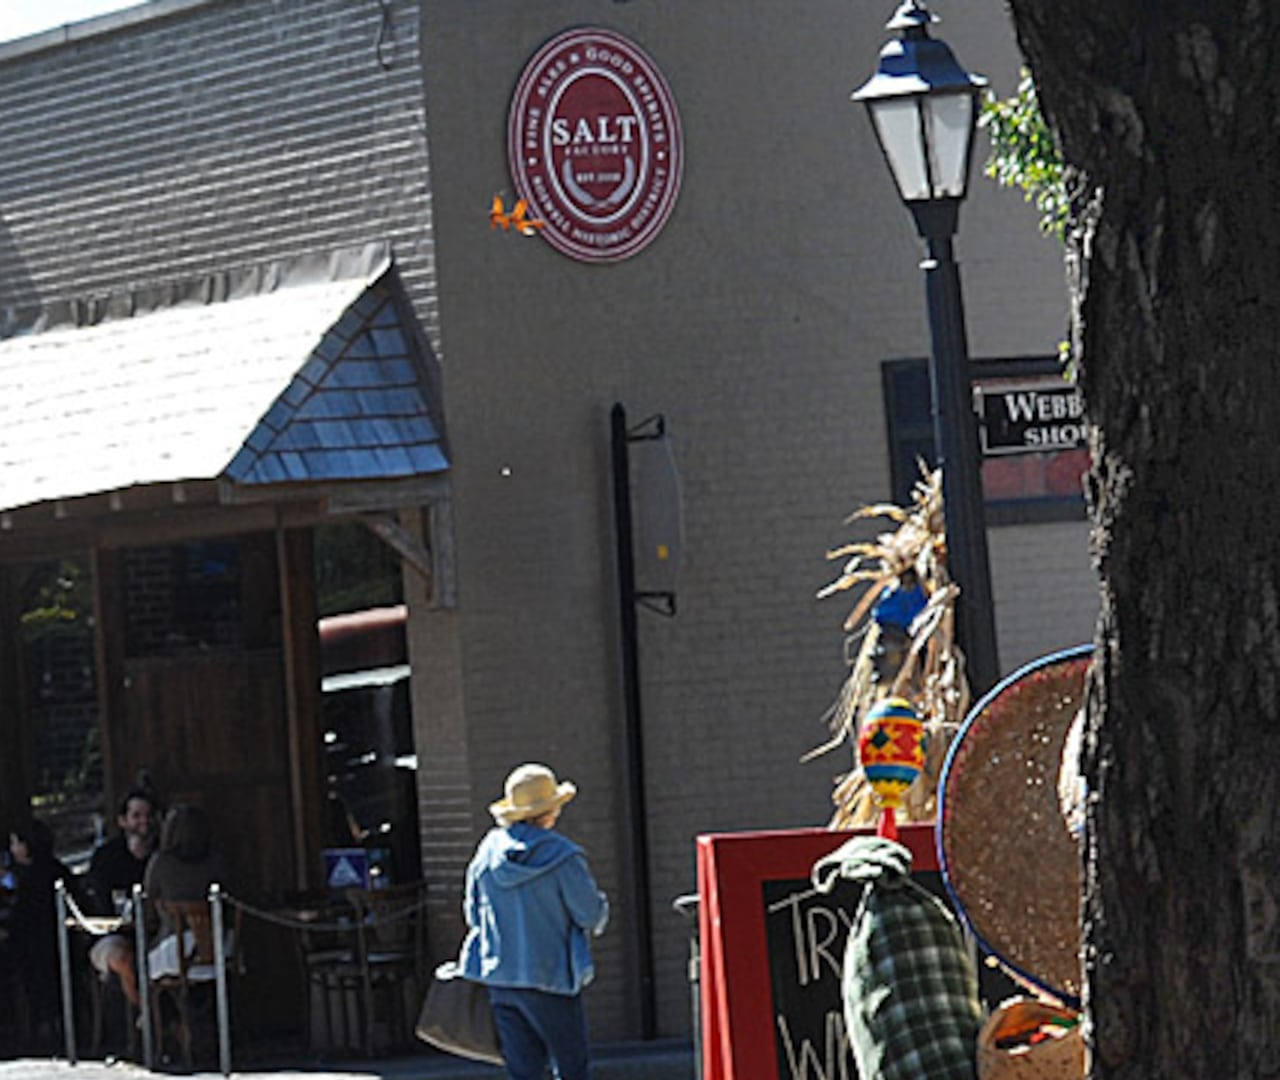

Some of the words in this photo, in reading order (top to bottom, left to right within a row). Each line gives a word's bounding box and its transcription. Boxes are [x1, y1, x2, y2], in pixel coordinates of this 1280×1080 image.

[585, 47, 633, 75] GOOD
[552, 115, 636, 146] SALT
[1005, 391, 1083, 422] WEBB
